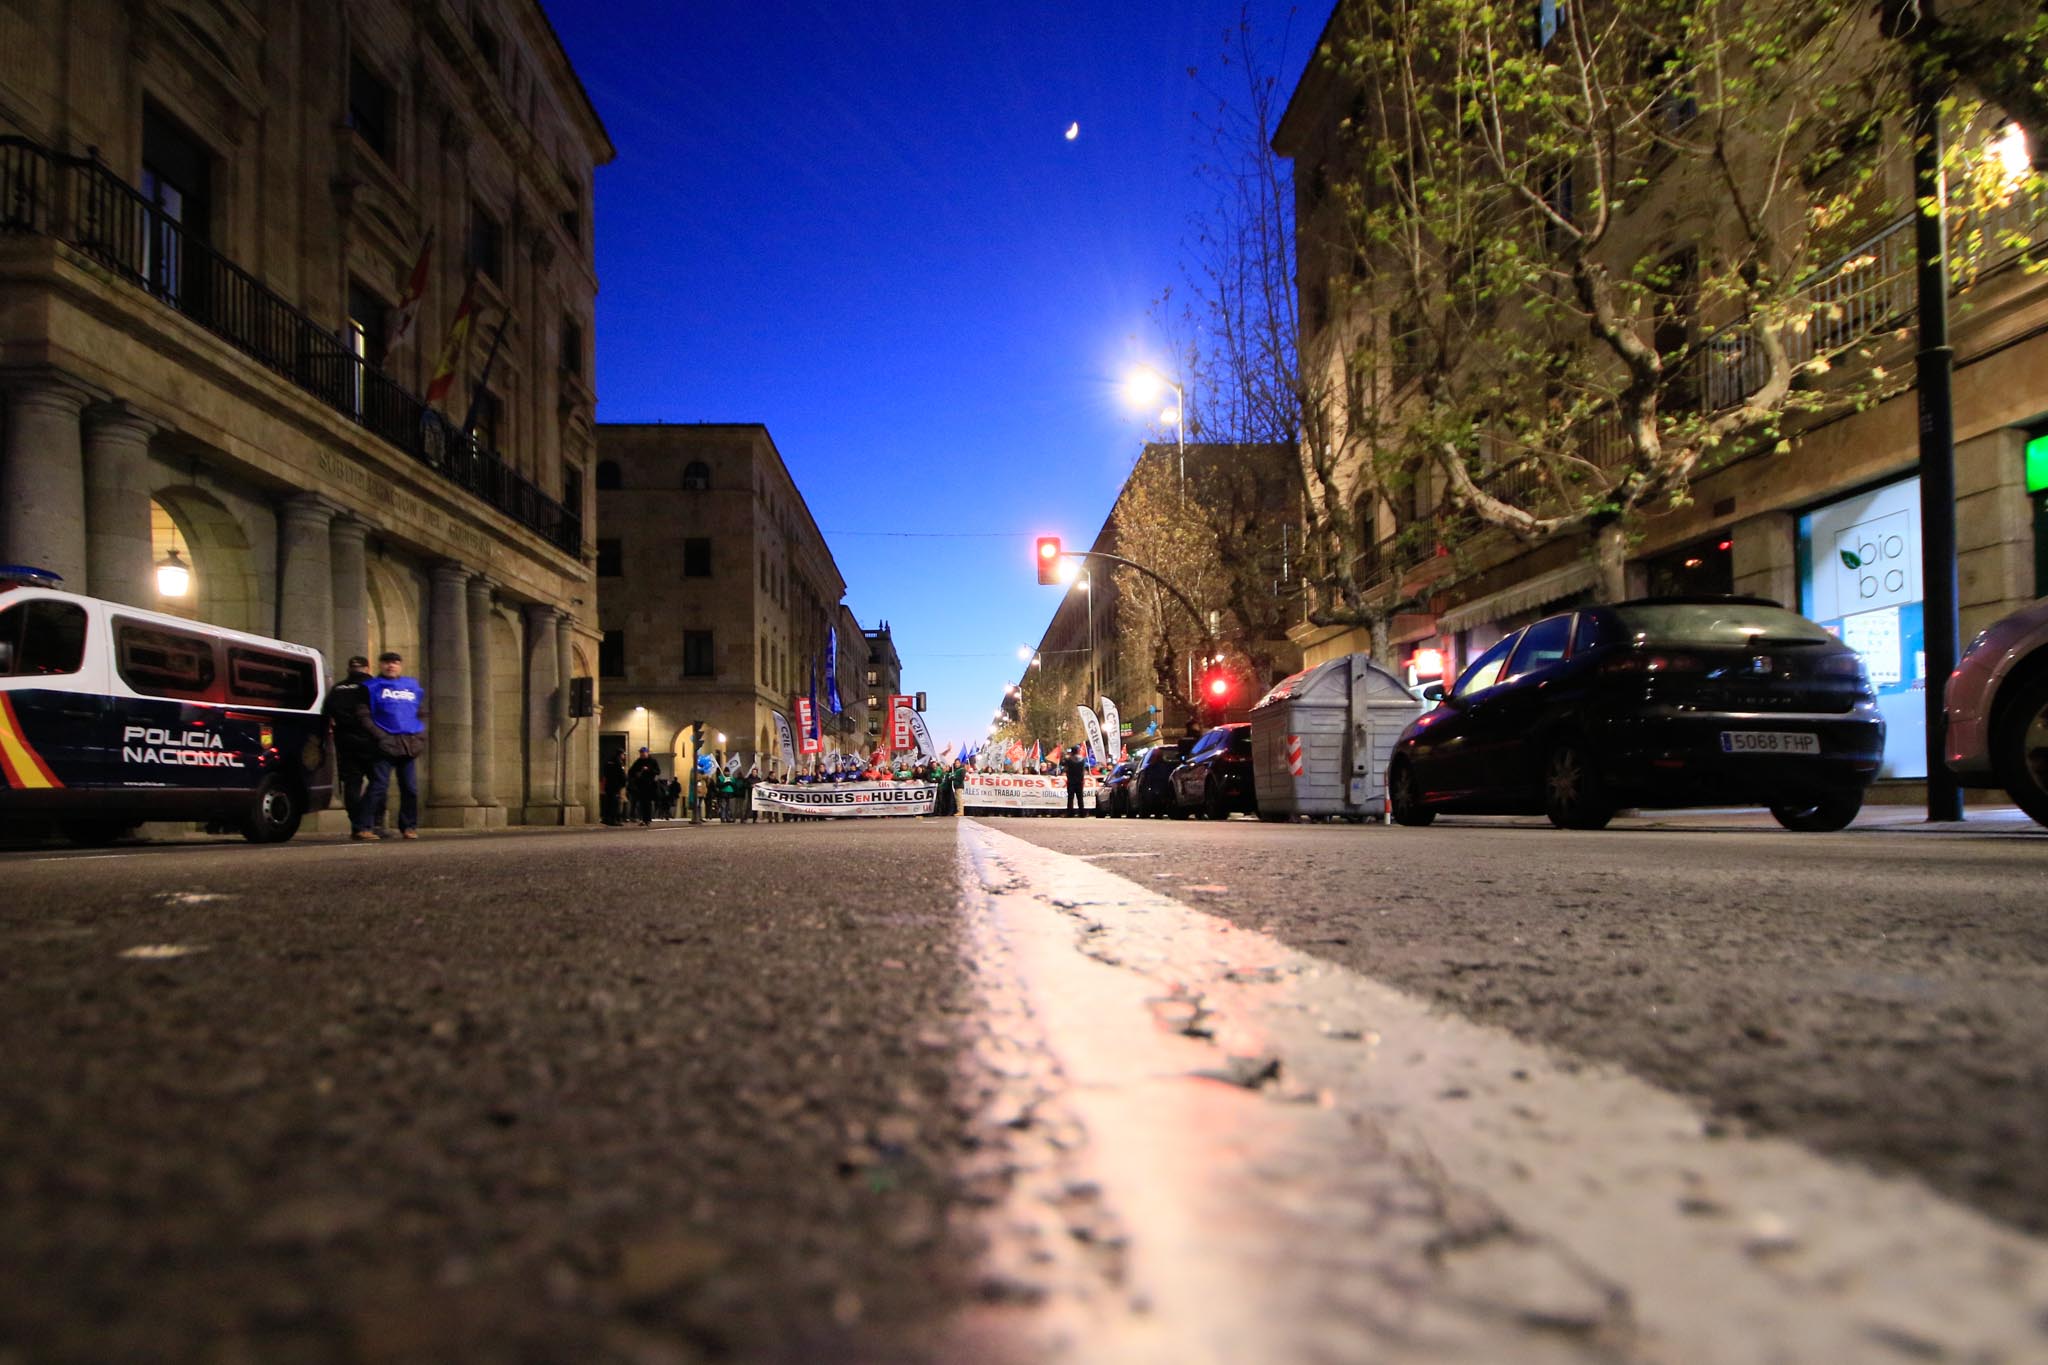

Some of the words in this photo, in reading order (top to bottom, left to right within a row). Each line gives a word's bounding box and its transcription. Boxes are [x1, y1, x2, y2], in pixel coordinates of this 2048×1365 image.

[1857, 534, 1904, 566] bio
[123, 726, 223, 749] POLICÍA
[1734, 734, 1778, 750] 5068
[1784, 735, 1813, 750] FHP
[123, 745, 245, 768] NACIONAL
[768, 792, 854, 803] PRISIONES
[872, 789, 934, 802] HUELGA
[994, 789, 1021, 797] TRABAJO
